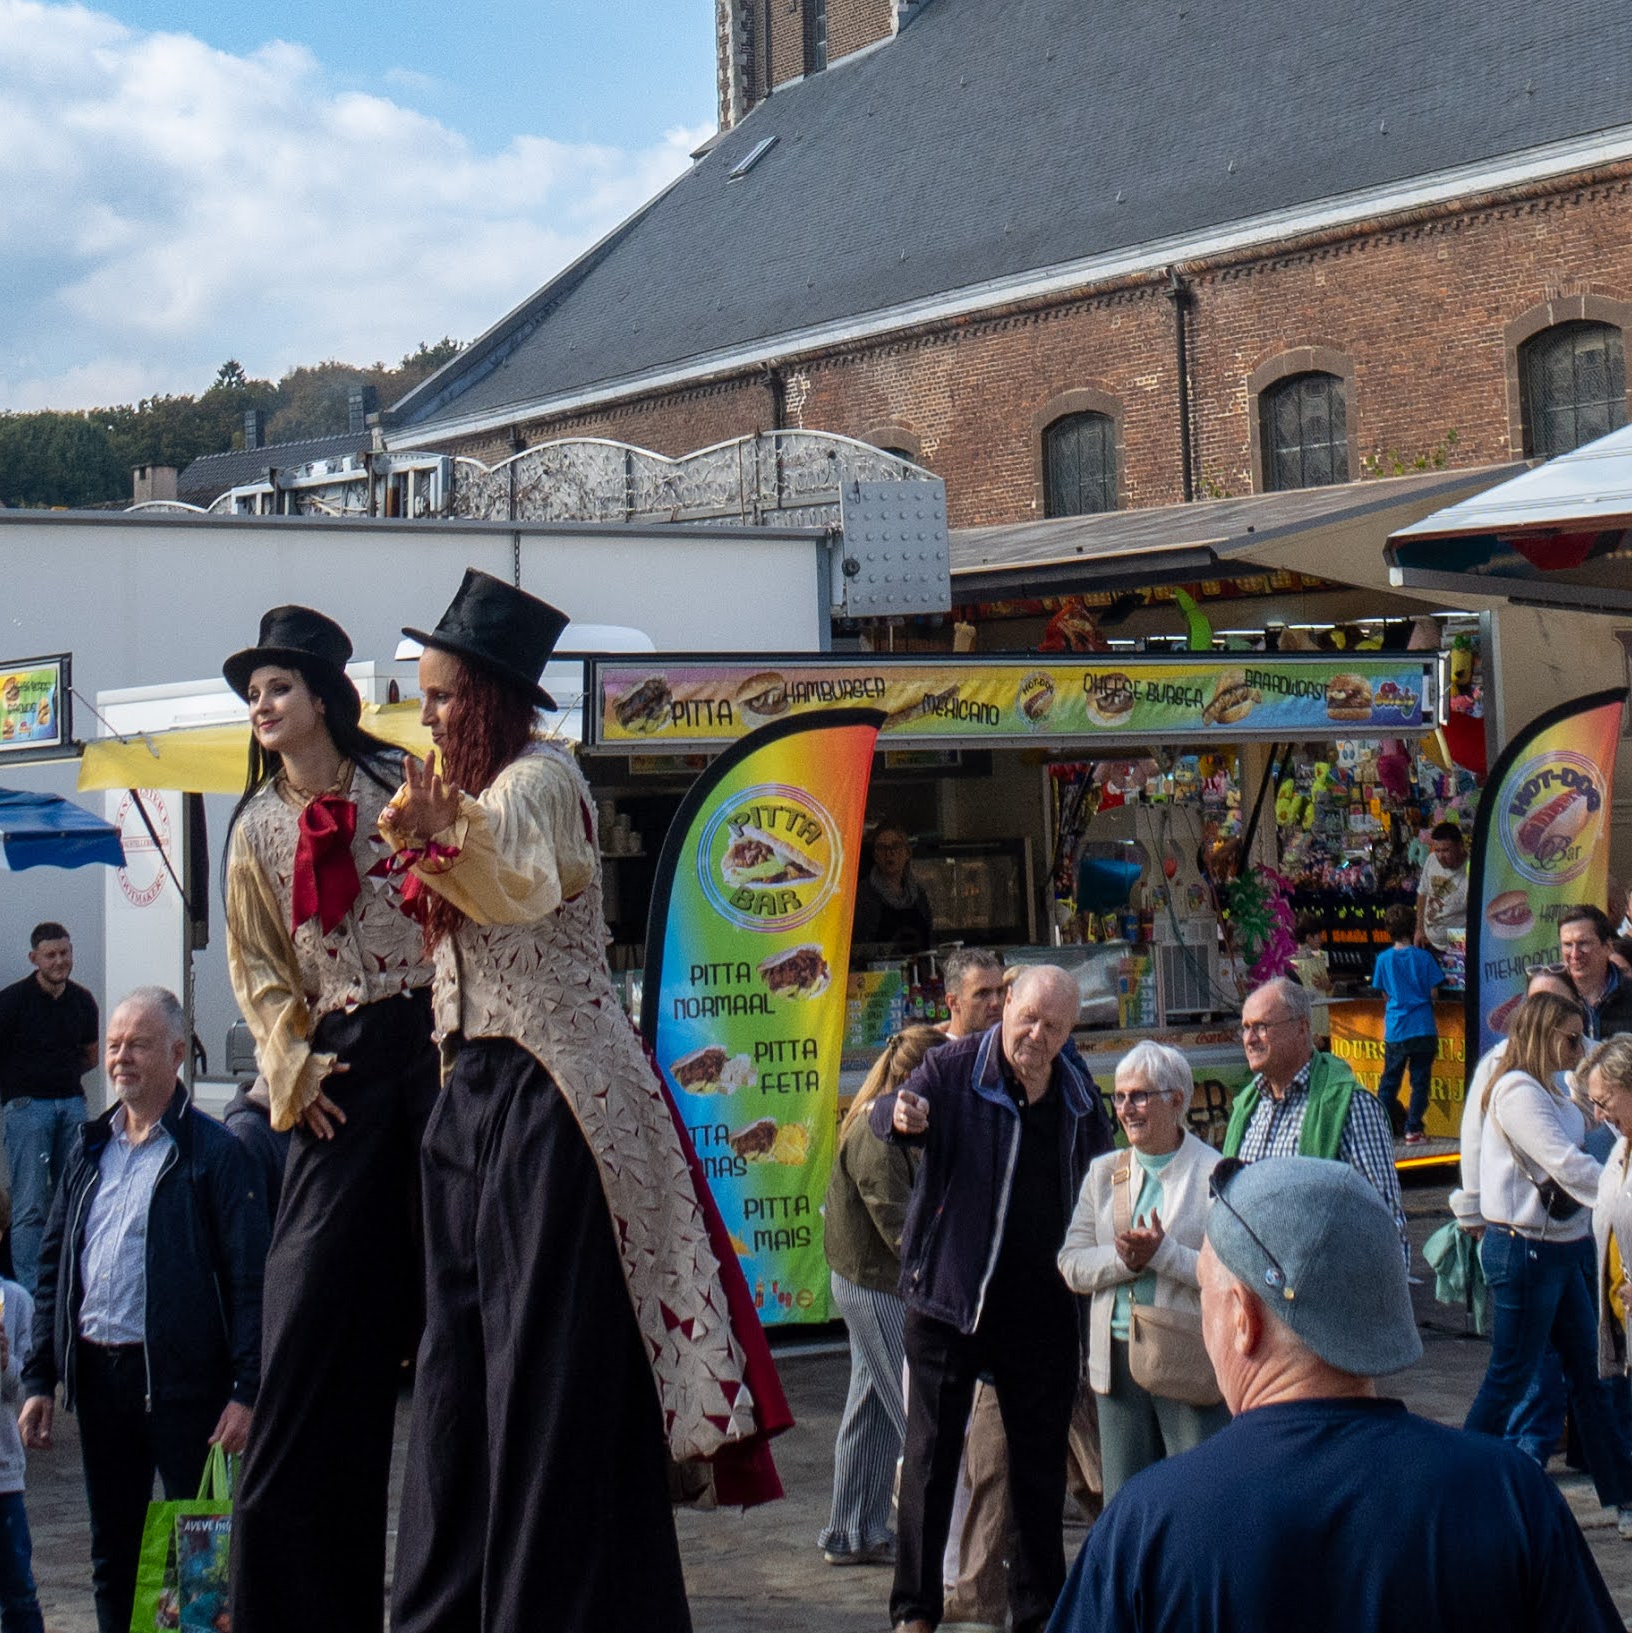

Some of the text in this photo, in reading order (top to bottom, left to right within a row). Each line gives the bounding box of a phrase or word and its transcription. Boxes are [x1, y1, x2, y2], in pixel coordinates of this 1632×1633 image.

[670, 677, 1000, 727] PITTA HAMBURGER MEXICANO
[1083, 671, 1142, 703] CHEESE
[1145, 681, 1205, 709] BURGER
[1508, 766, 1601, 818] HOT-DOG
[726, 804, 822, 846] PITTA
[1530, 834, 1582, 870] Bar
[729, 885, 803, 916] BAR
[690, 961, 751, 986] PITTA
[673, 993, 776, 1020] NORMAAL
[753, 1038, 818, 1064] PITTA
[1437, 1037, 1465, 1063] TIJ
[760, 1070, 819, 1095] FETA
[1430, 1077, 1465, 1102] RIJ
[687, 1123, 730, 1147] TTA
[698, 1154, 748, 1179] NAS
[743, 1194, 810, 1220] PITTA
[753, 1225, 811, 1253] MAIS
